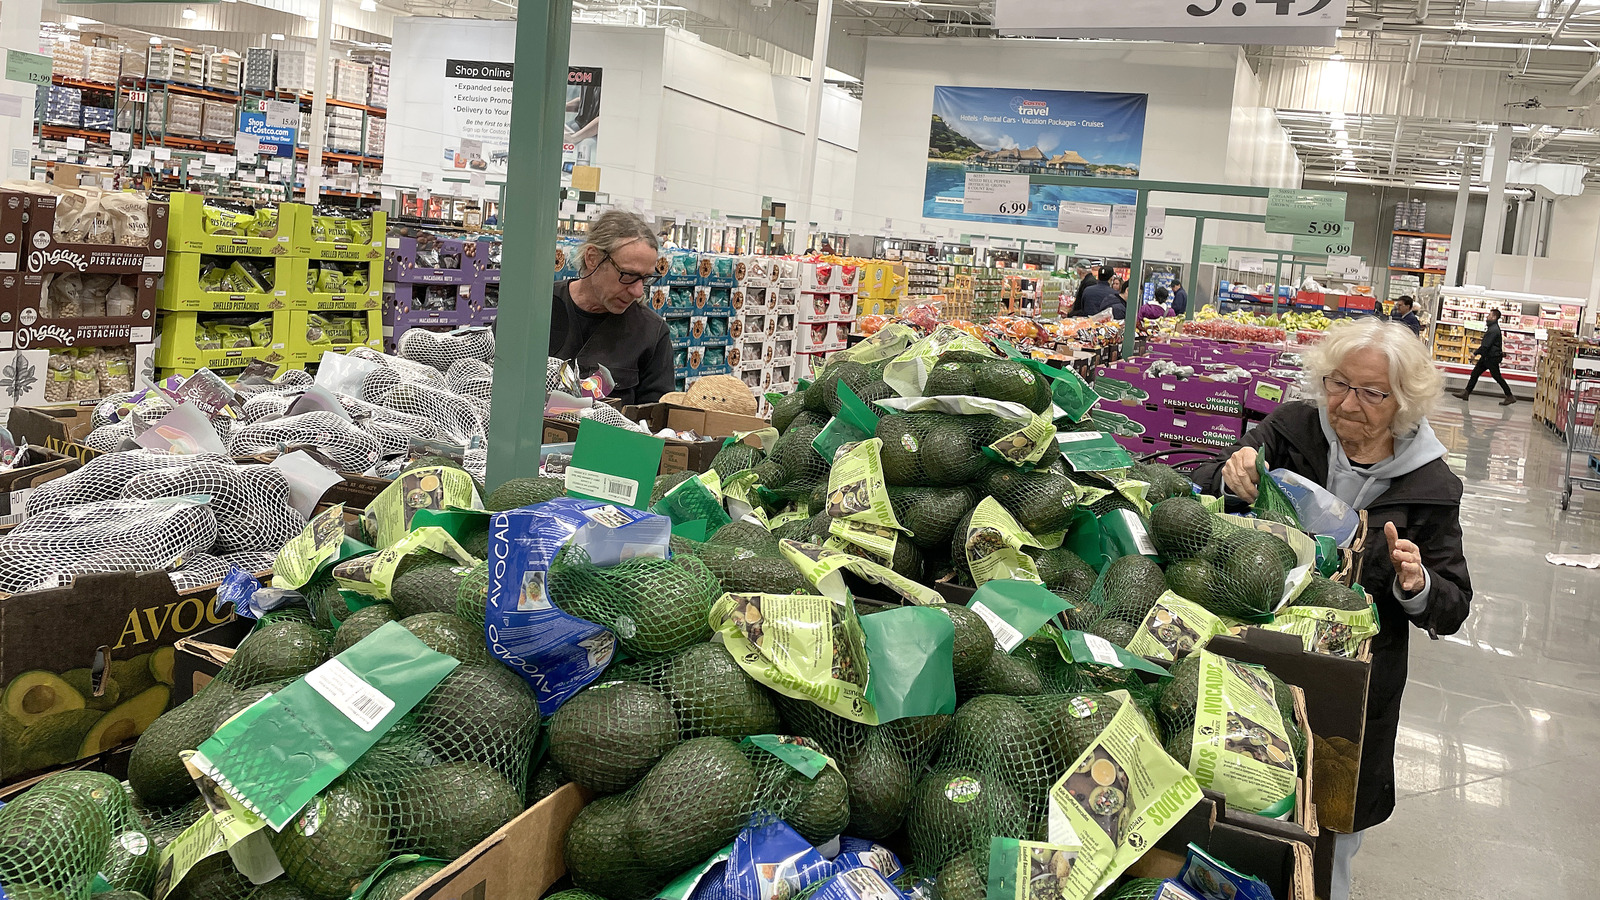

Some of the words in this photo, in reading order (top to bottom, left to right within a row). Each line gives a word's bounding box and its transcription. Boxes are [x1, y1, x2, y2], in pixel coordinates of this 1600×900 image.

[28, 72, 51, 83] 12.99
[455, 65, 479, 78] Shop
[481, 67, 511, 78] Online
[568, 71, 592, 82] COM
[458, 83, 492, 93] Expanded
[494, 85, 513, 93] select
[130, 91, 145, 102] 311
[457, 94, 488, 103] Exclusive
[490, 96, 512, 105] Promo
[456, 106, 483, 115] Delivery
[494, 108, 509, 116] Your
[1018, 105, 1049, 116] travel
[248, 117, 265, 127] Shop
[484, 119, 494, 127] first
[960, 114, 978, 122] Hotels
[982, 115, 1002, 123] Rental
[1002, 116, 1016, 124] Cars
[1021, 117, 1047, 125] Vacation
[1048, 118, 1077, 128] Packages
[1081, 119, 1105, 128] Cruises
[252, 127, 289, 136] Costco.com
[489, 127, 506, 135] Costco
[999, 202, 1026, 215] 6.99
[1042, 204, 1057, 212] Click
[1086, 224, 1108, 235] 7.99
[1146, 227, 1163, 237] .99
[1308, 221, 1341, 236] 5.99
[215, 244, 235, 254] SHELLED
[235, 245, 263, 255] PISTACHIOS
[1325, 243, 1350, 254] 6.99
[320, 250, 338, 258] SHELLED
[337, 250, 360, 259] PISTACHIOS
[27, 249, 89, 273] Organic
[89, 255, 143, 267] PISTACHIOS
[212, 301, 233, 310] SHELLED
[232, 302, 260, 311] PISTACHIOS
[317, 301, 334, 309] SHELLED
[334, 301, 357, 310] PISTACHIOS
[15, 324, 75, 349] Organic
[76, 328, 130, 340] PISTACHIOS
[208, 358, 230, 368] SHELLED
[229, 357, 254, 367] PISTACH
[1163, 398, 1188, 406] FRESH
[1189, 401, 1239, 414] CUCUMBERS
[1205, 396, 1240, 406] ORGANIC
[1159, 431, 1184, 440] FRESH
[1202, 430, 1236, 441] ORGANIC
[490, 513, 510, 608] AVOCAD
[112, 594, 233, 651] AVOC
[488, 623, 552, 693] AVOCADO
[763, 663, 841, 706] AVOCADOS
[1203, 663, 1223, 716] AVOCADOS
[1195, 748, 1218, 789] ADOS
[1146, 774, 1199, 827] OCADOS
[216, 814, 235, 828] REDUC
